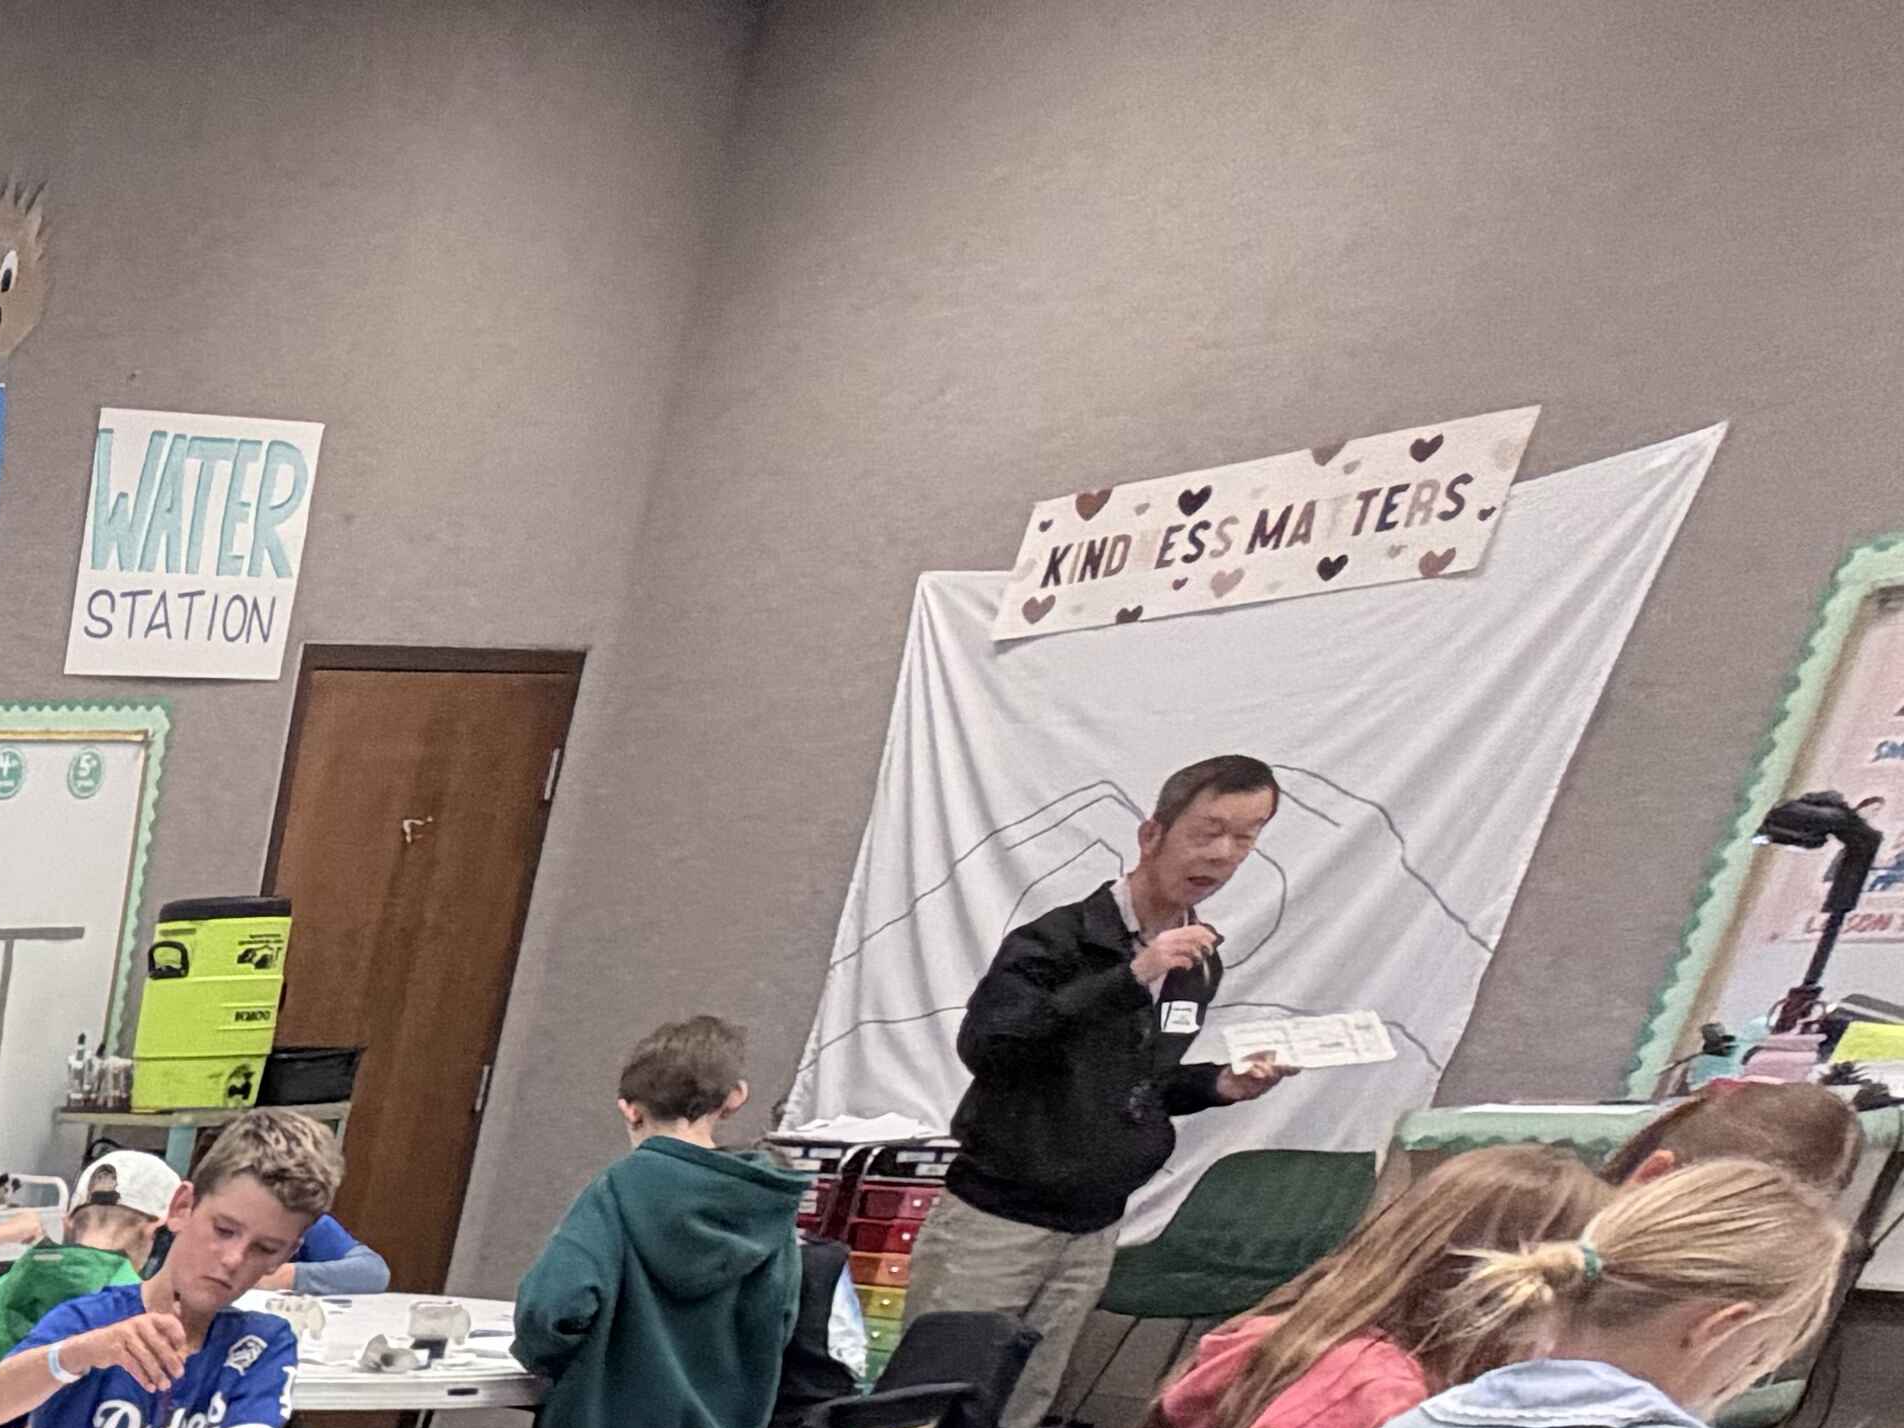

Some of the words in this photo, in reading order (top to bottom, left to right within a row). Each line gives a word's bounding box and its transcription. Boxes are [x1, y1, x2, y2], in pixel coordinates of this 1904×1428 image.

[91, 427, 308, 579] WATER
[1040, 515, 1239, 588] KINDESS
[1245, 473, 1473, 555] MATERS
[83, 589, 277, 645] STATION
